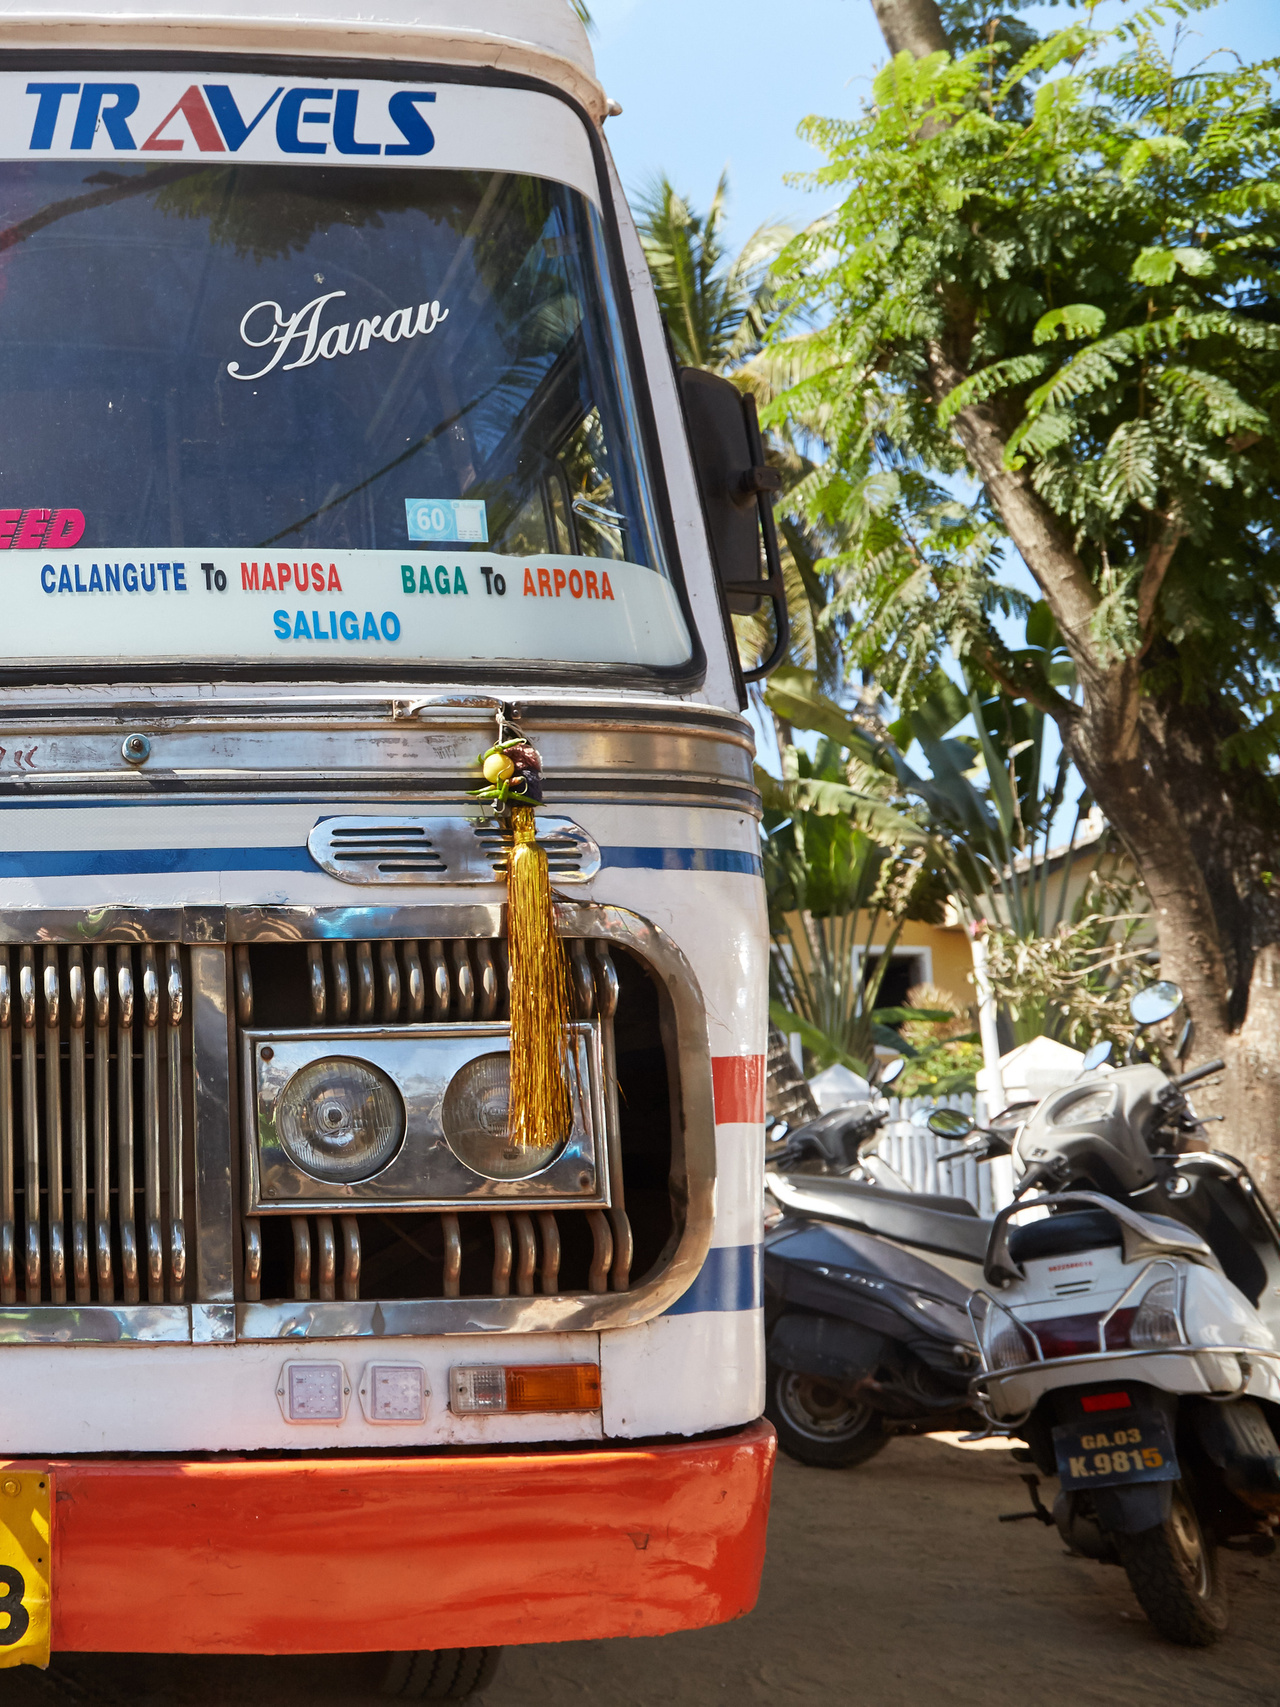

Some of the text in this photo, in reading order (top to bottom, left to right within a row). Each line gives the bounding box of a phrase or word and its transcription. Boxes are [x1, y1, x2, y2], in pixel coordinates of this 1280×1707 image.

[25, 82, 438, 156] TRAVELS
[227, 290, 450, 380] Aarav
[416, 507, 446, 532] 60
[40, 562, 343, 594] CALANGUTE To MAPUSA
[400, 564, 616, 601] BAGA To ARPORA
[273, 609, 402, 642] SALIGAO
[1068, 1447, 1164, 1479] K.9815
